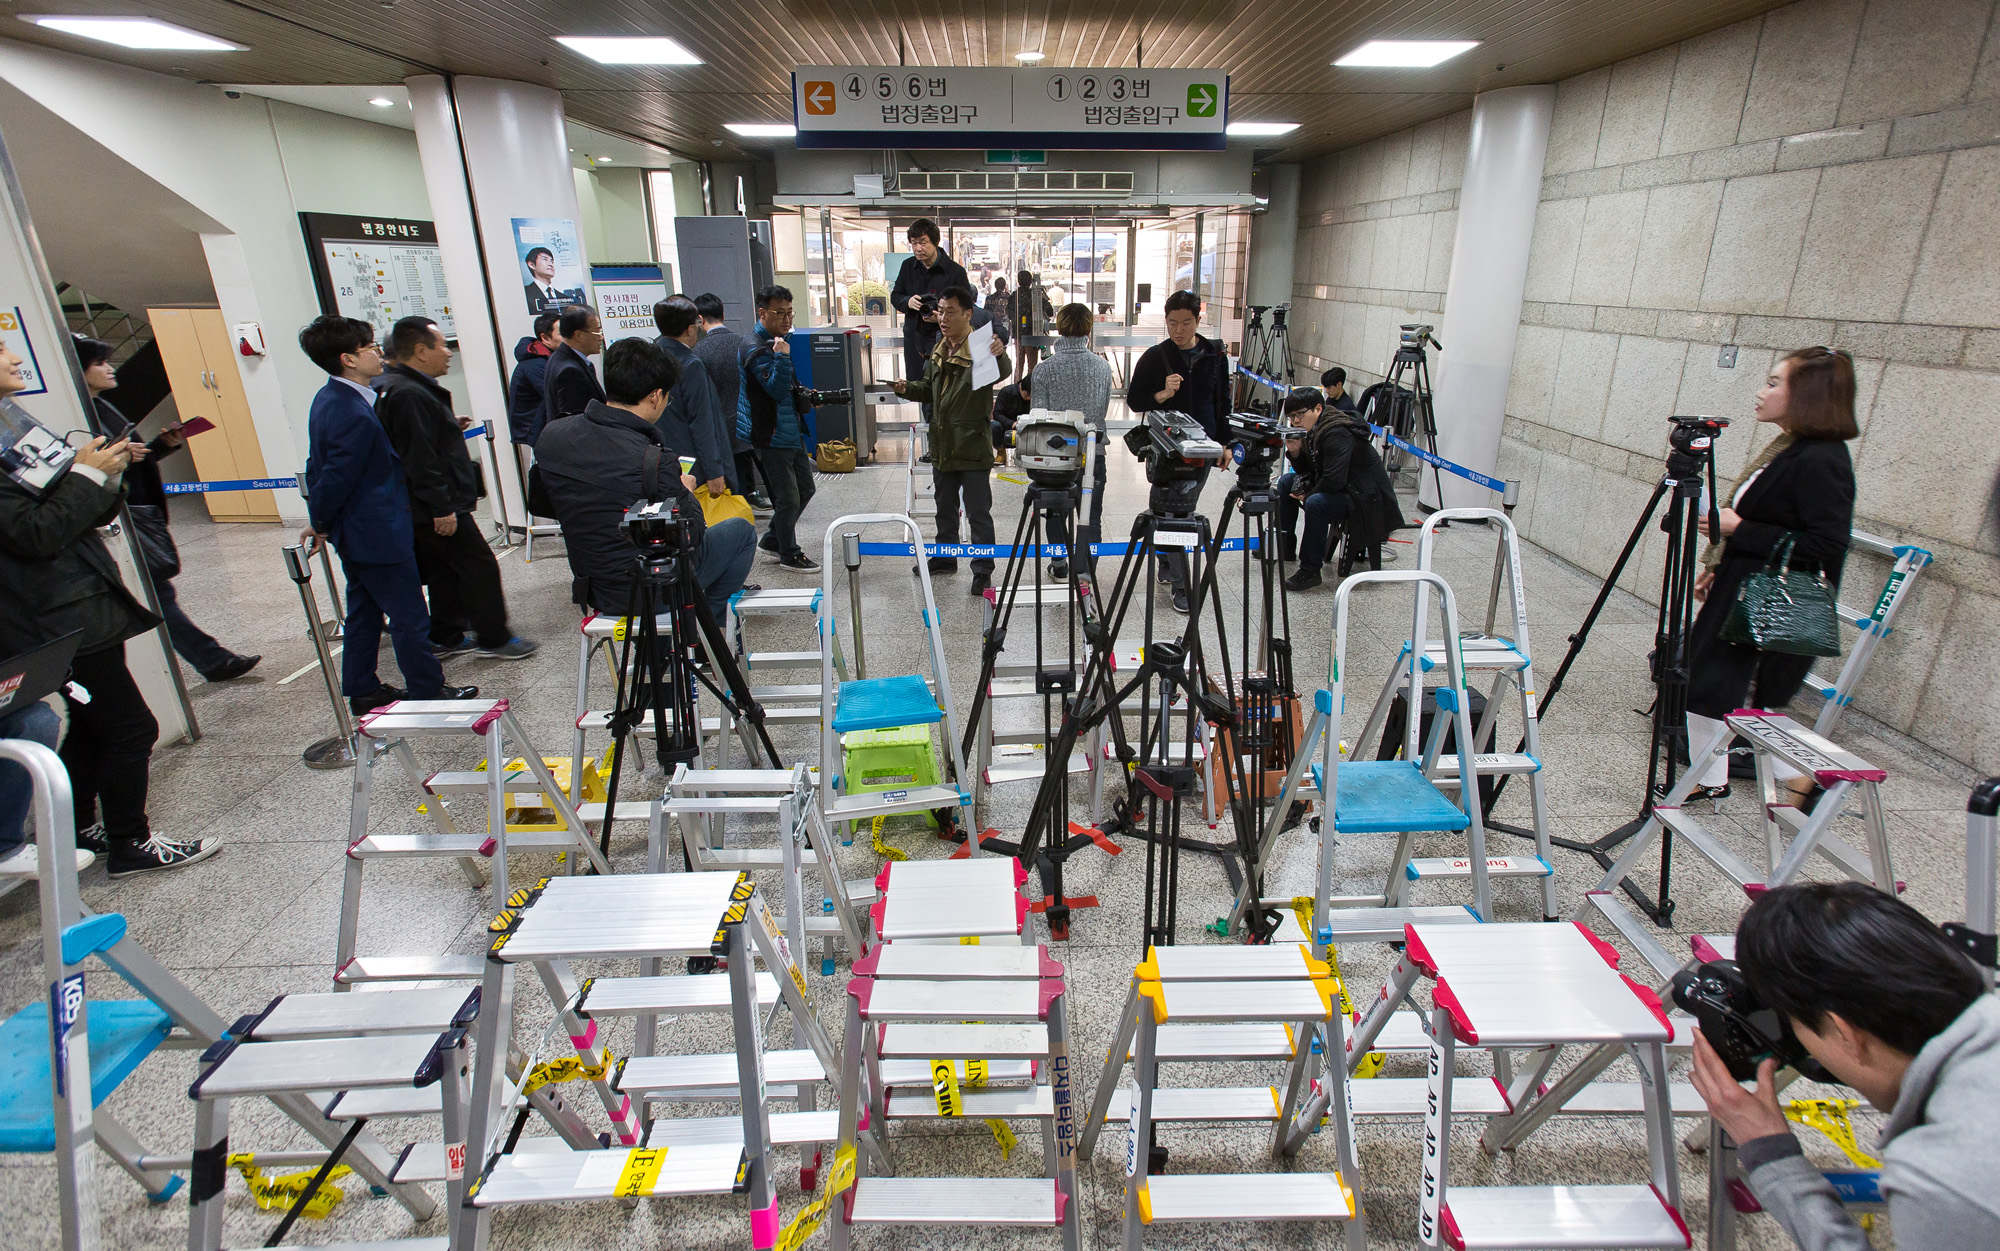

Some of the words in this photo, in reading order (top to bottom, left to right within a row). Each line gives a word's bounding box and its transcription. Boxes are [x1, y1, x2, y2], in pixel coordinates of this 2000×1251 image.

[881, 104, 979, 125] 법정출입구
[1084, 105, 1180, 126] 법정출입구
[361, 221, 420, 237] 법정안내도
[603, 293, 639, 304] 형사재판
[252, 480, 276, 489] Seoul
[1162, 534, 1197, 544] REUTERS
[908, 545, 937, 555] Soul
[940, 546, 964, 556] High
[967, 546, 995, 556] Court
[64, 976, 83, 1025] KBS
[1053, 1055, 1075, 1158] 디지털타임스
[1428, 1083, 1438, 1118] AP
[1426, 1123, 1436, 1158] AP
[1424, 1164, 1435, 1199] AP
[1421, 1204, 1433, 1240] AP
